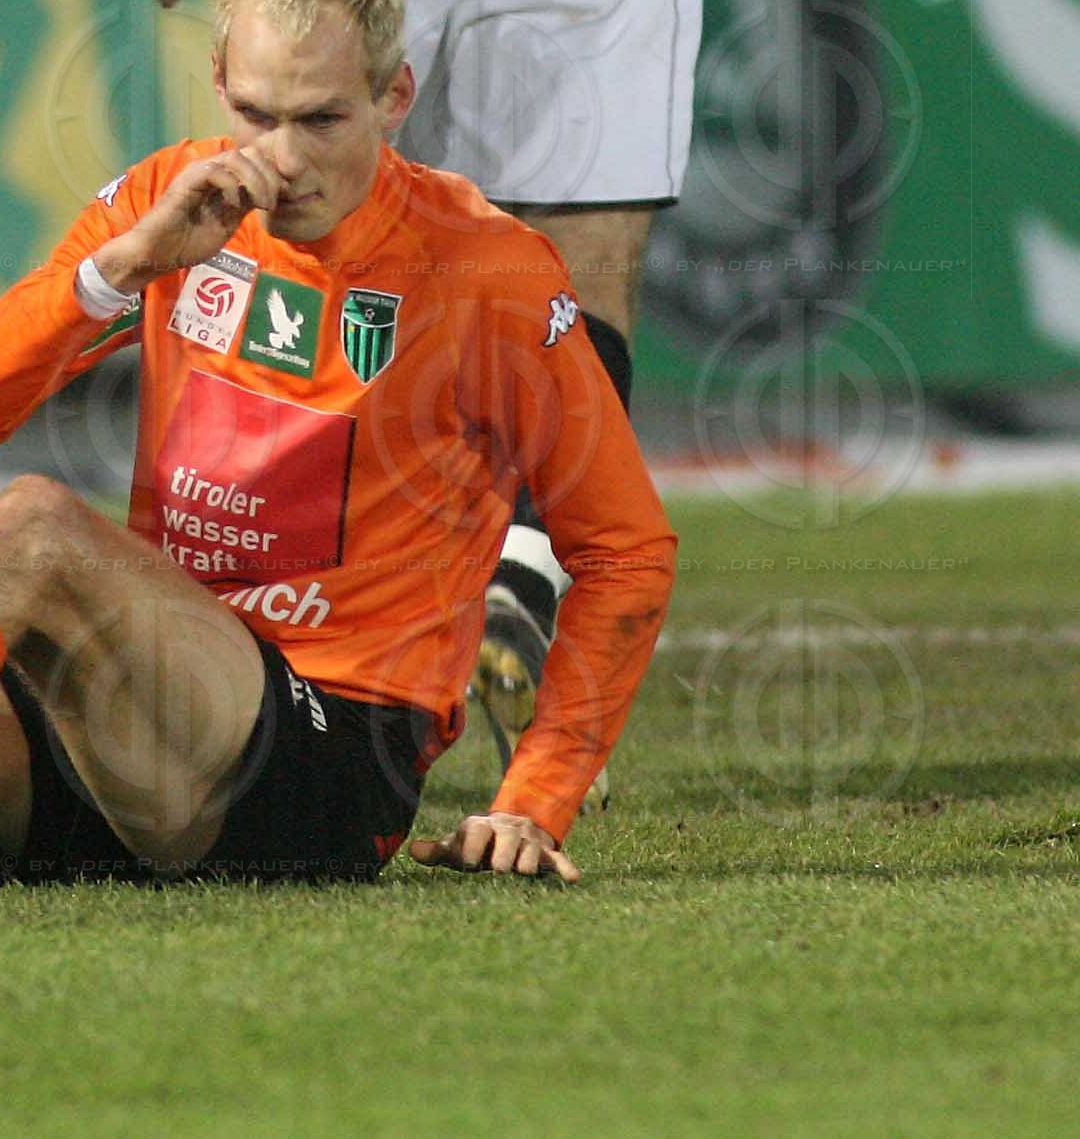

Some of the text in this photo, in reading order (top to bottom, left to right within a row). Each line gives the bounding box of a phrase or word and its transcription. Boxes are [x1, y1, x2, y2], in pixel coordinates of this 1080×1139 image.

[169, 317, 226, 350] LIGA
[170, 465, 266, 517] tiroler
[163, 505, 279, 552] wasser
[161, 532, 238, 573] kraft
